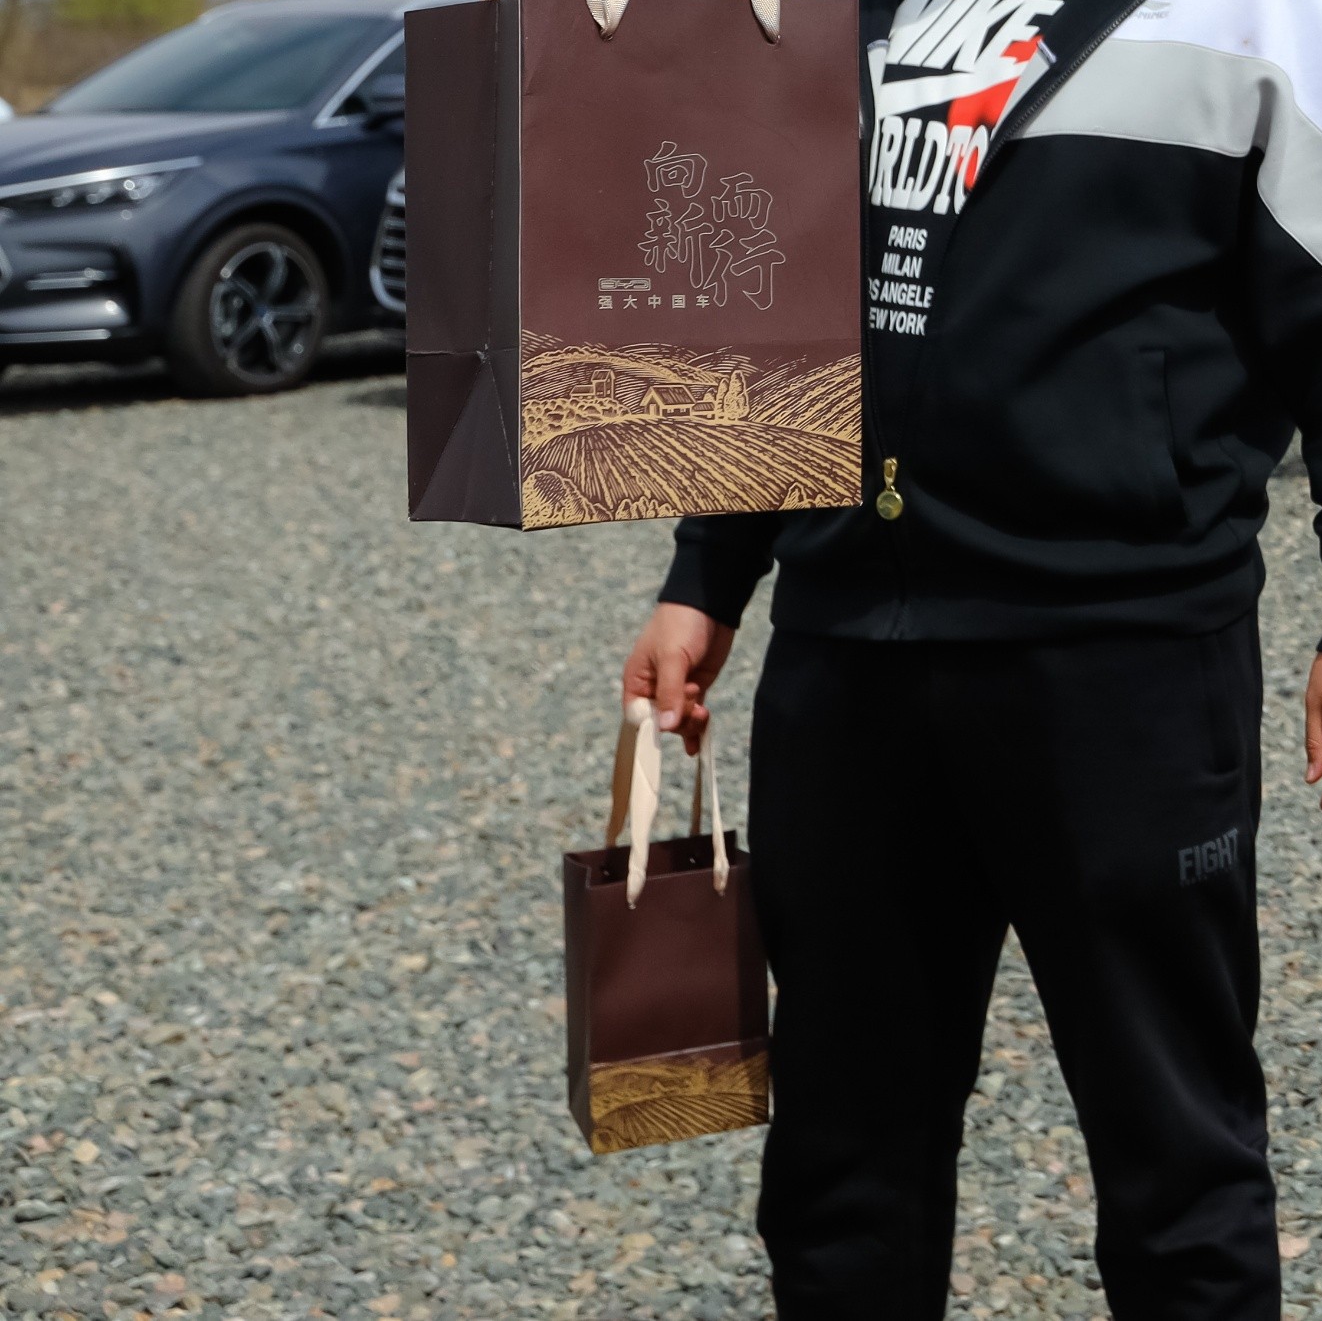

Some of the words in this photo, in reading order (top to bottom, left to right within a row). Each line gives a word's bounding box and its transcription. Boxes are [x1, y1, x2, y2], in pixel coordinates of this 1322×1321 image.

[888, 225, 928, 251] PARIS
[881, 252, 923, 278] MILAN
[598, 294, 711, 310] 强大中国车
[880, 281, 935, 308] ANGELE
[869, 307, 889, 330] EW
[887, 311, 928, 336] YORK
[1178, 827, 1238, 882] FIGHT
